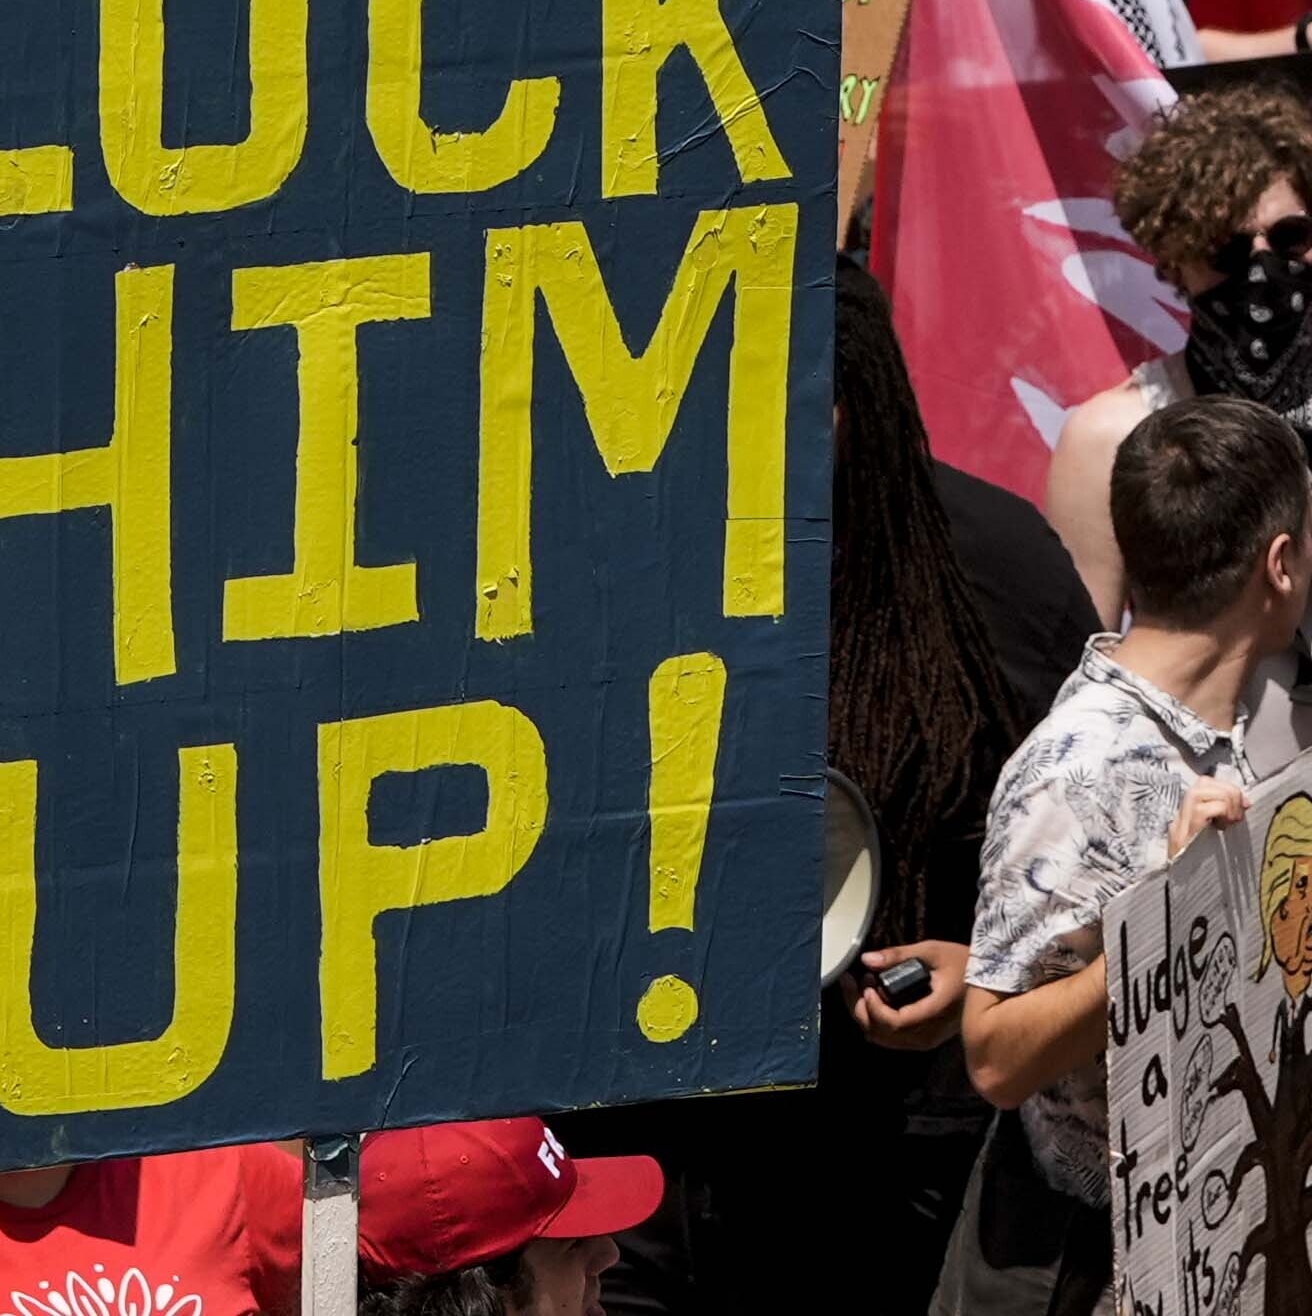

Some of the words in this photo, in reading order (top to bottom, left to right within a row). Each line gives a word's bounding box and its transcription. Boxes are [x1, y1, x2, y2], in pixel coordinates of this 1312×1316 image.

[1110, 882, 1209, 1048] Judge
[1141, 1053, 1169, 1109] a
[1115, 1115, 1191, 1254] tree
